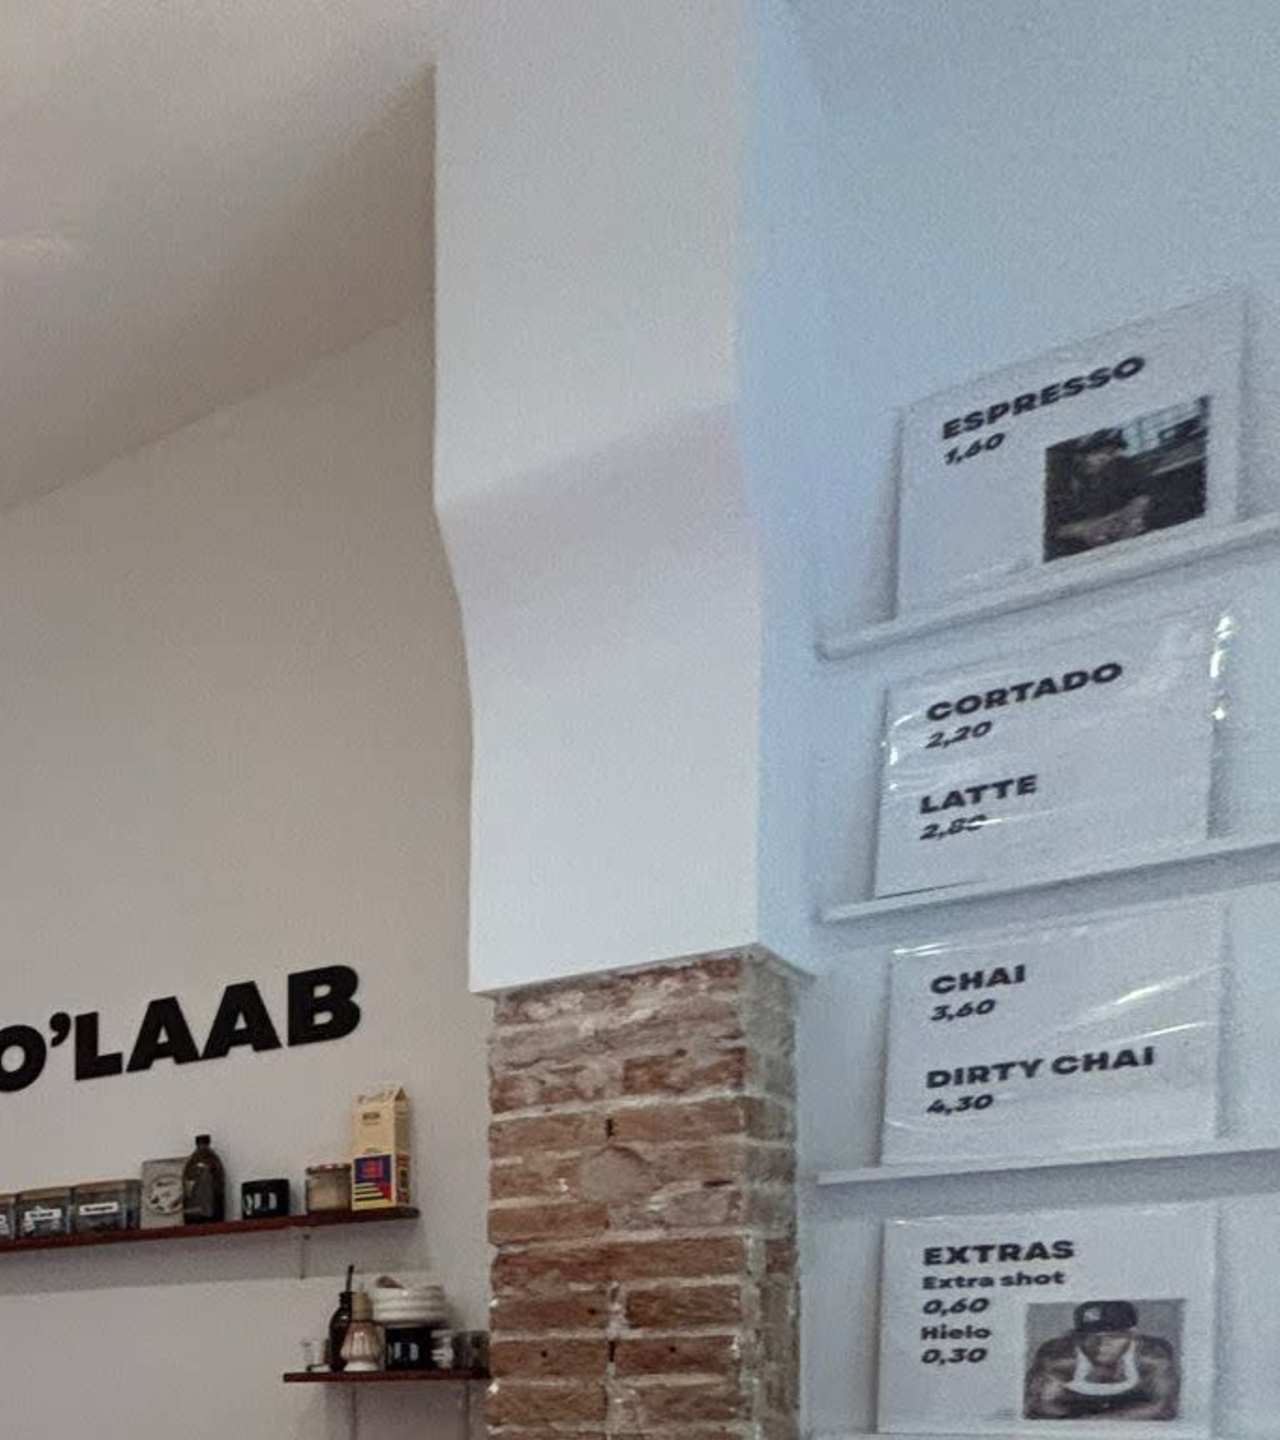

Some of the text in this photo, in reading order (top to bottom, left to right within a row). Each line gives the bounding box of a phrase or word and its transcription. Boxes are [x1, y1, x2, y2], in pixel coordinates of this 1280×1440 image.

[942, 356, 1145, 440] ESPRESSO
[943, 432, 1006, 466] 1,60
[926, 662, 1123, 721] CORTADO
[925, 720, 993, 749] 2,20
[920, 774, 1038, 814] LATTE
[930, 964, 1026, 994] CHAI
[930, 998, 996, 1023] 3,60
[925, 1046, 1155, 1090] DIRTY CHAI
[925, 1093, 994, 1115] 4,30
[923, 1240, 1075, 1267] EXTRAS
[922, 1268, 1066, 1291] Extra shot
[922, 1297, 989, 1316] 0,60
[921, 1323, 992, 1342] Hielo
[921, 1345, 987, 1365] 0,30
